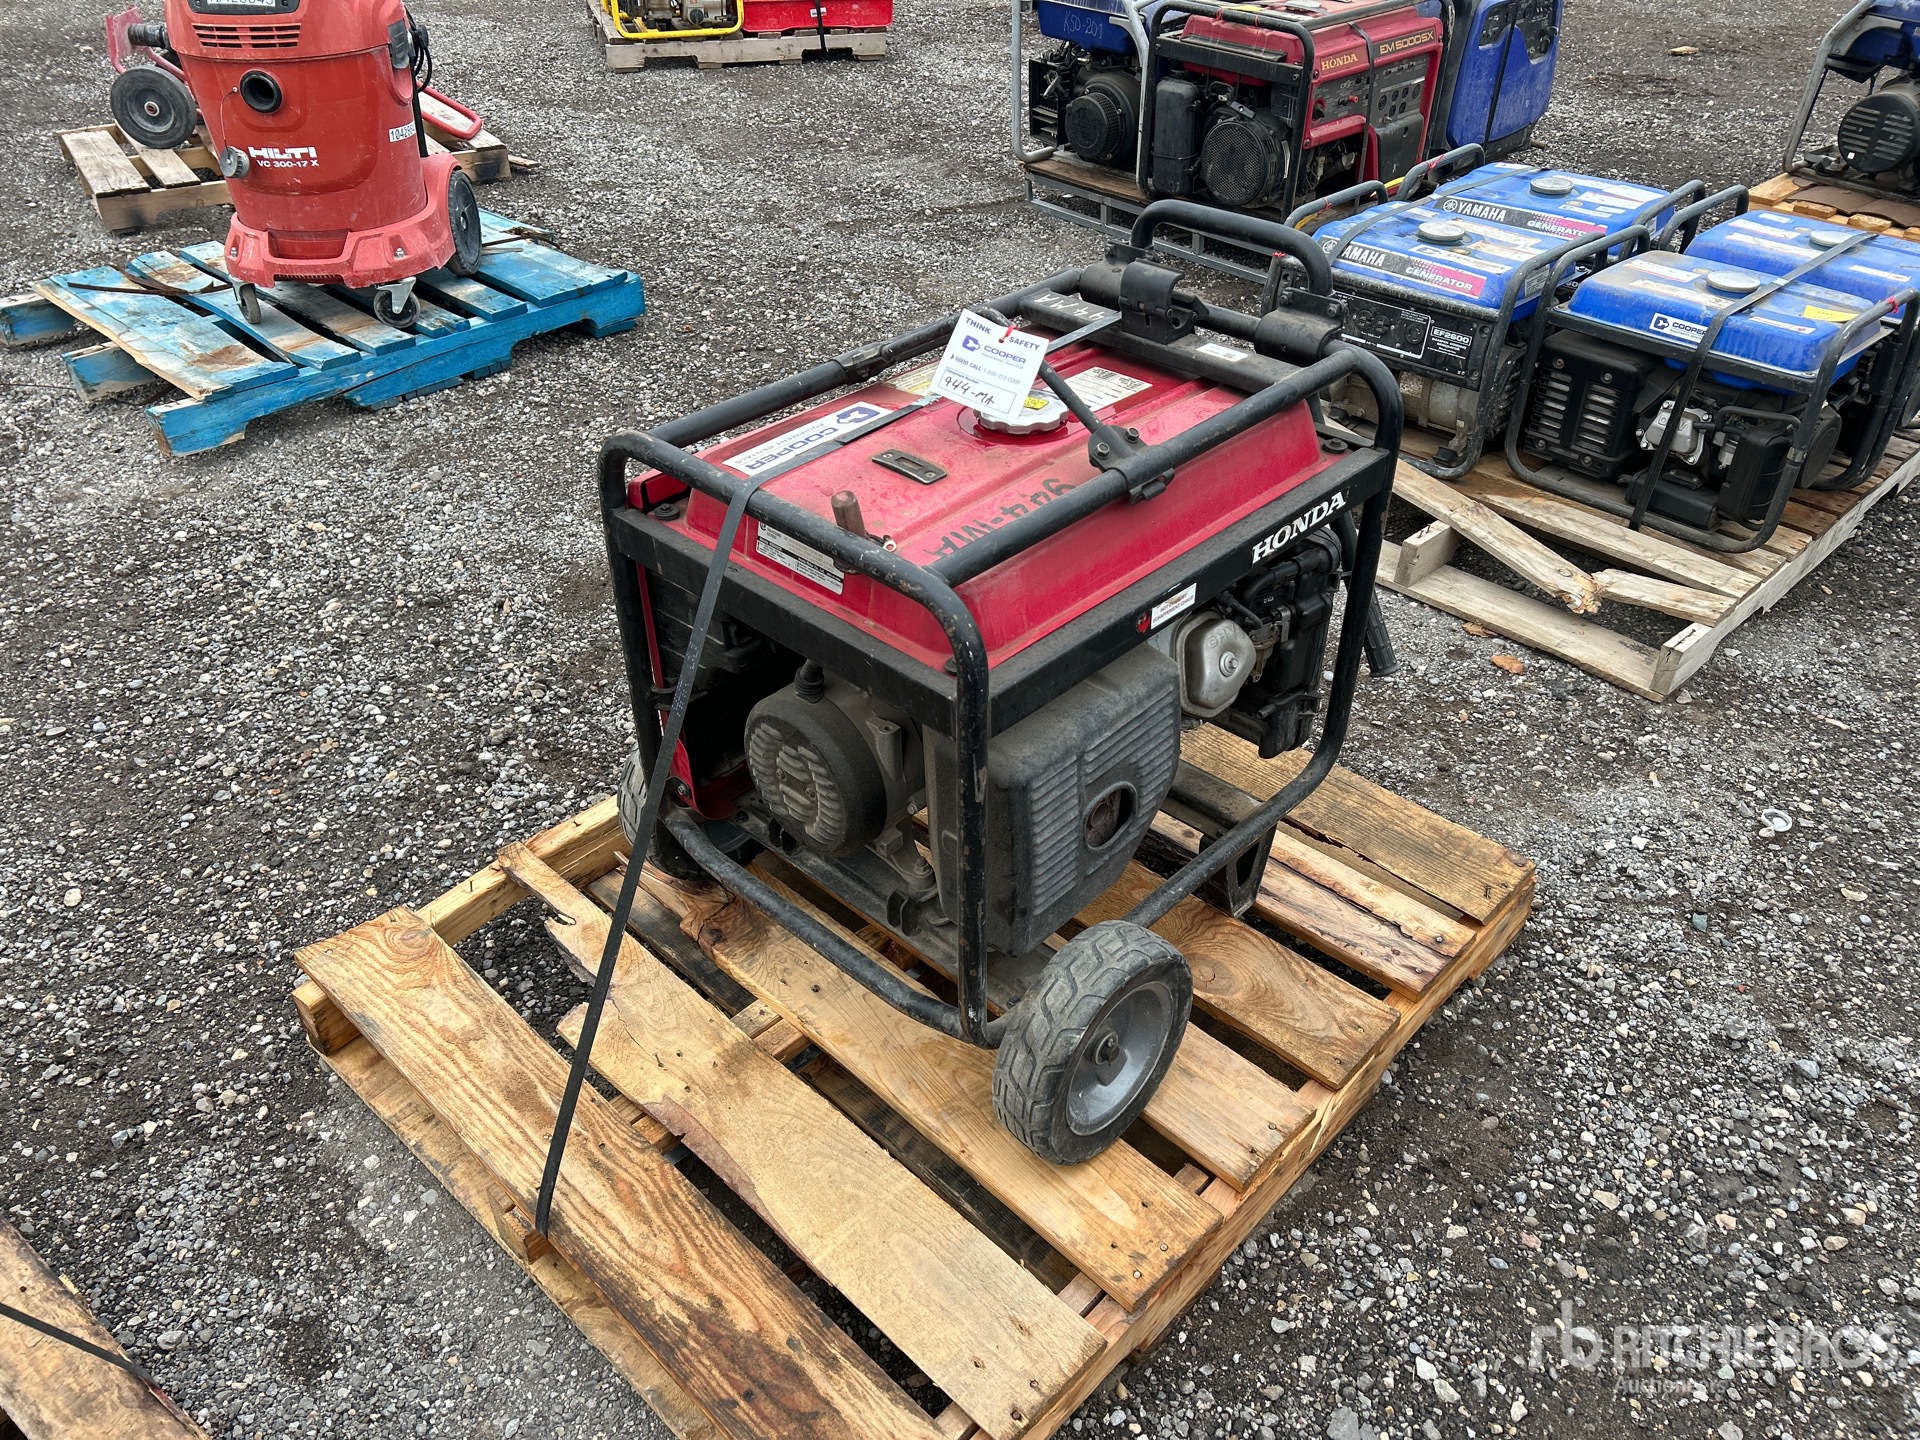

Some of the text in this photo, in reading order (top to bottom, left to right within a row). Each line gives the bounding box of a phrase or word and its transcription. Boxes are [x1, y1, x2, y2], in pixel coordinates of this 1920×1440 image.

[1379, 31, 1435, 55] EM5000SX
[1321, 53, 1359, 70] HONDA
[248, 147, 317, 158] HILTI
[273, 160, 307, 168] 300-17
[309, 159, 319, 167] X
[1457, 200, 1507, 222] YAMAHA
[1526, 219, 1588, 237] GENERATO
[1341, 245, 1386, 267] AMAHA
[1405, 266, 1473, 291] GENERATOR
[965, 316, 1041, 351] THINK SAFETY
[1433, 329, 1470, 345] EF2600
[954, 355, 969, 366] GOOD
[969, 361, 982, 372] CALL
[983, 344, 1027, 365] COOPER
[944, 375, 995, 406] 944-MA
[734, 422, 825, 465] EQUIPMENT RENTALS
[745, 427, 839, 471] COOPER
[1252, 491, 1347, 564] HONDA
